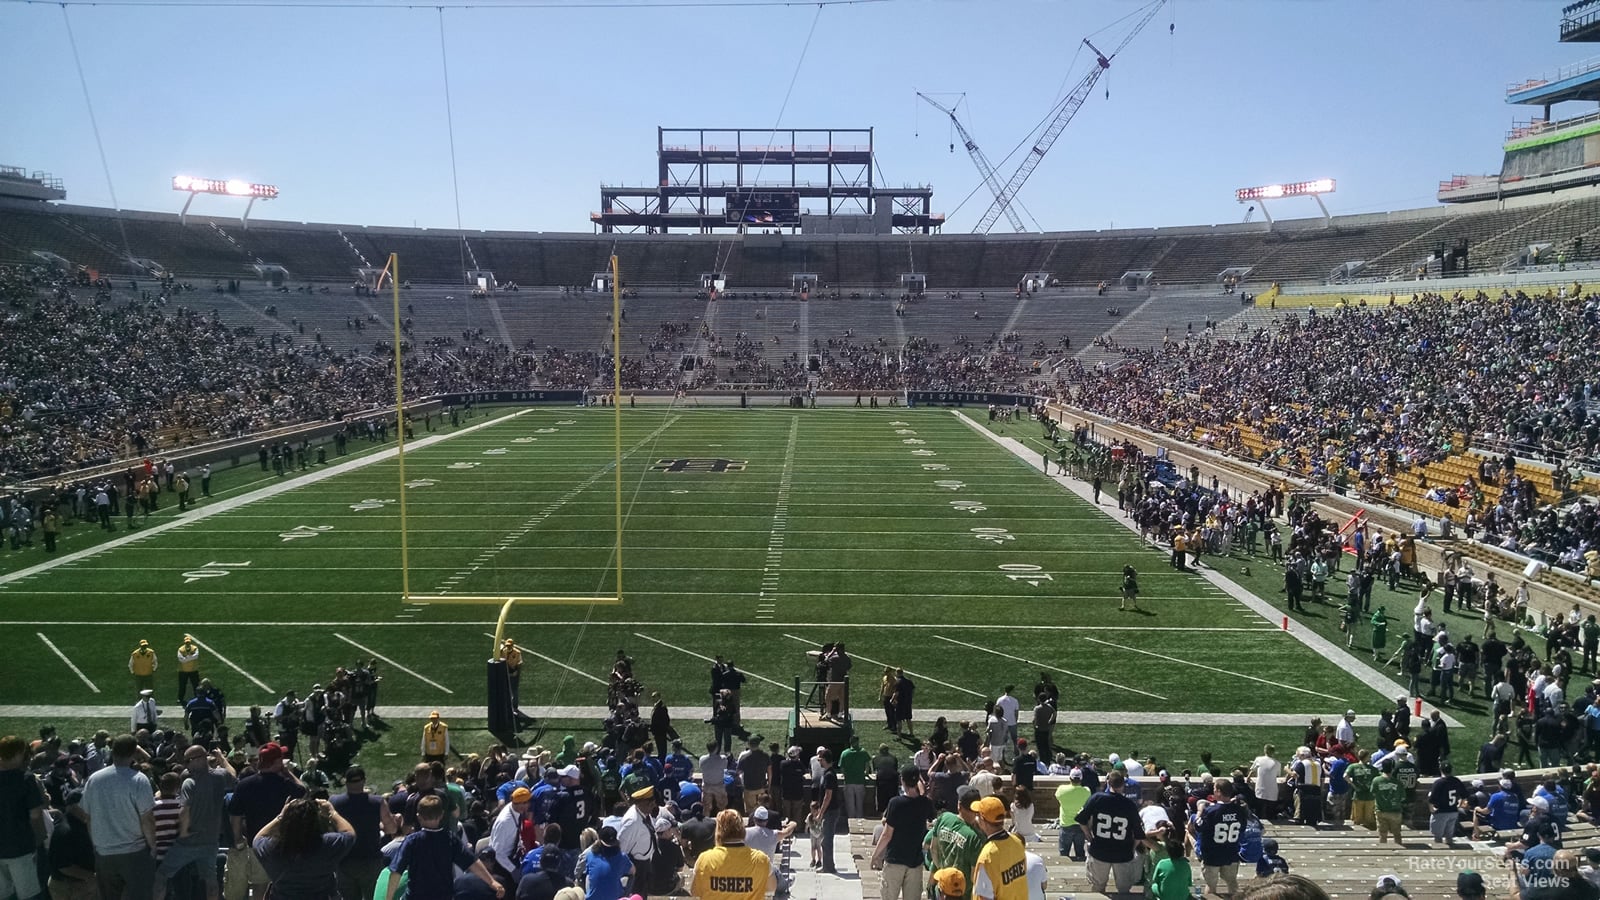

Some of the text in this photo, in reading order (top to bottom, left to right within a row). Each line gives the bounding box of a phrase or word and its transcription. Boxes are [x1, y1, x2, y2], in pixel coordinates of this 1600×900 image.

[460, 393, 498, 401] NOTRE
[919, 393, 988, 401] FIGHTING
[278, 525, 335, 541] 20
[970, 527, 1016, 544] 20
[181, 561, 252, 580] 10
[998, 563, 1054, 582] 10
[1398, 773, 1416, 789] 50
[663, 788, 671, 801] 9
[1448, 790, 1457, 806] 5
[576, 801, 585, 819] 3
[1096, 813, 1129, 841] 23
[1213, 821, 1241, 844] 66
[1001, 861, 1026, 886] USHE
[710, 876, 754, 892] USHER
